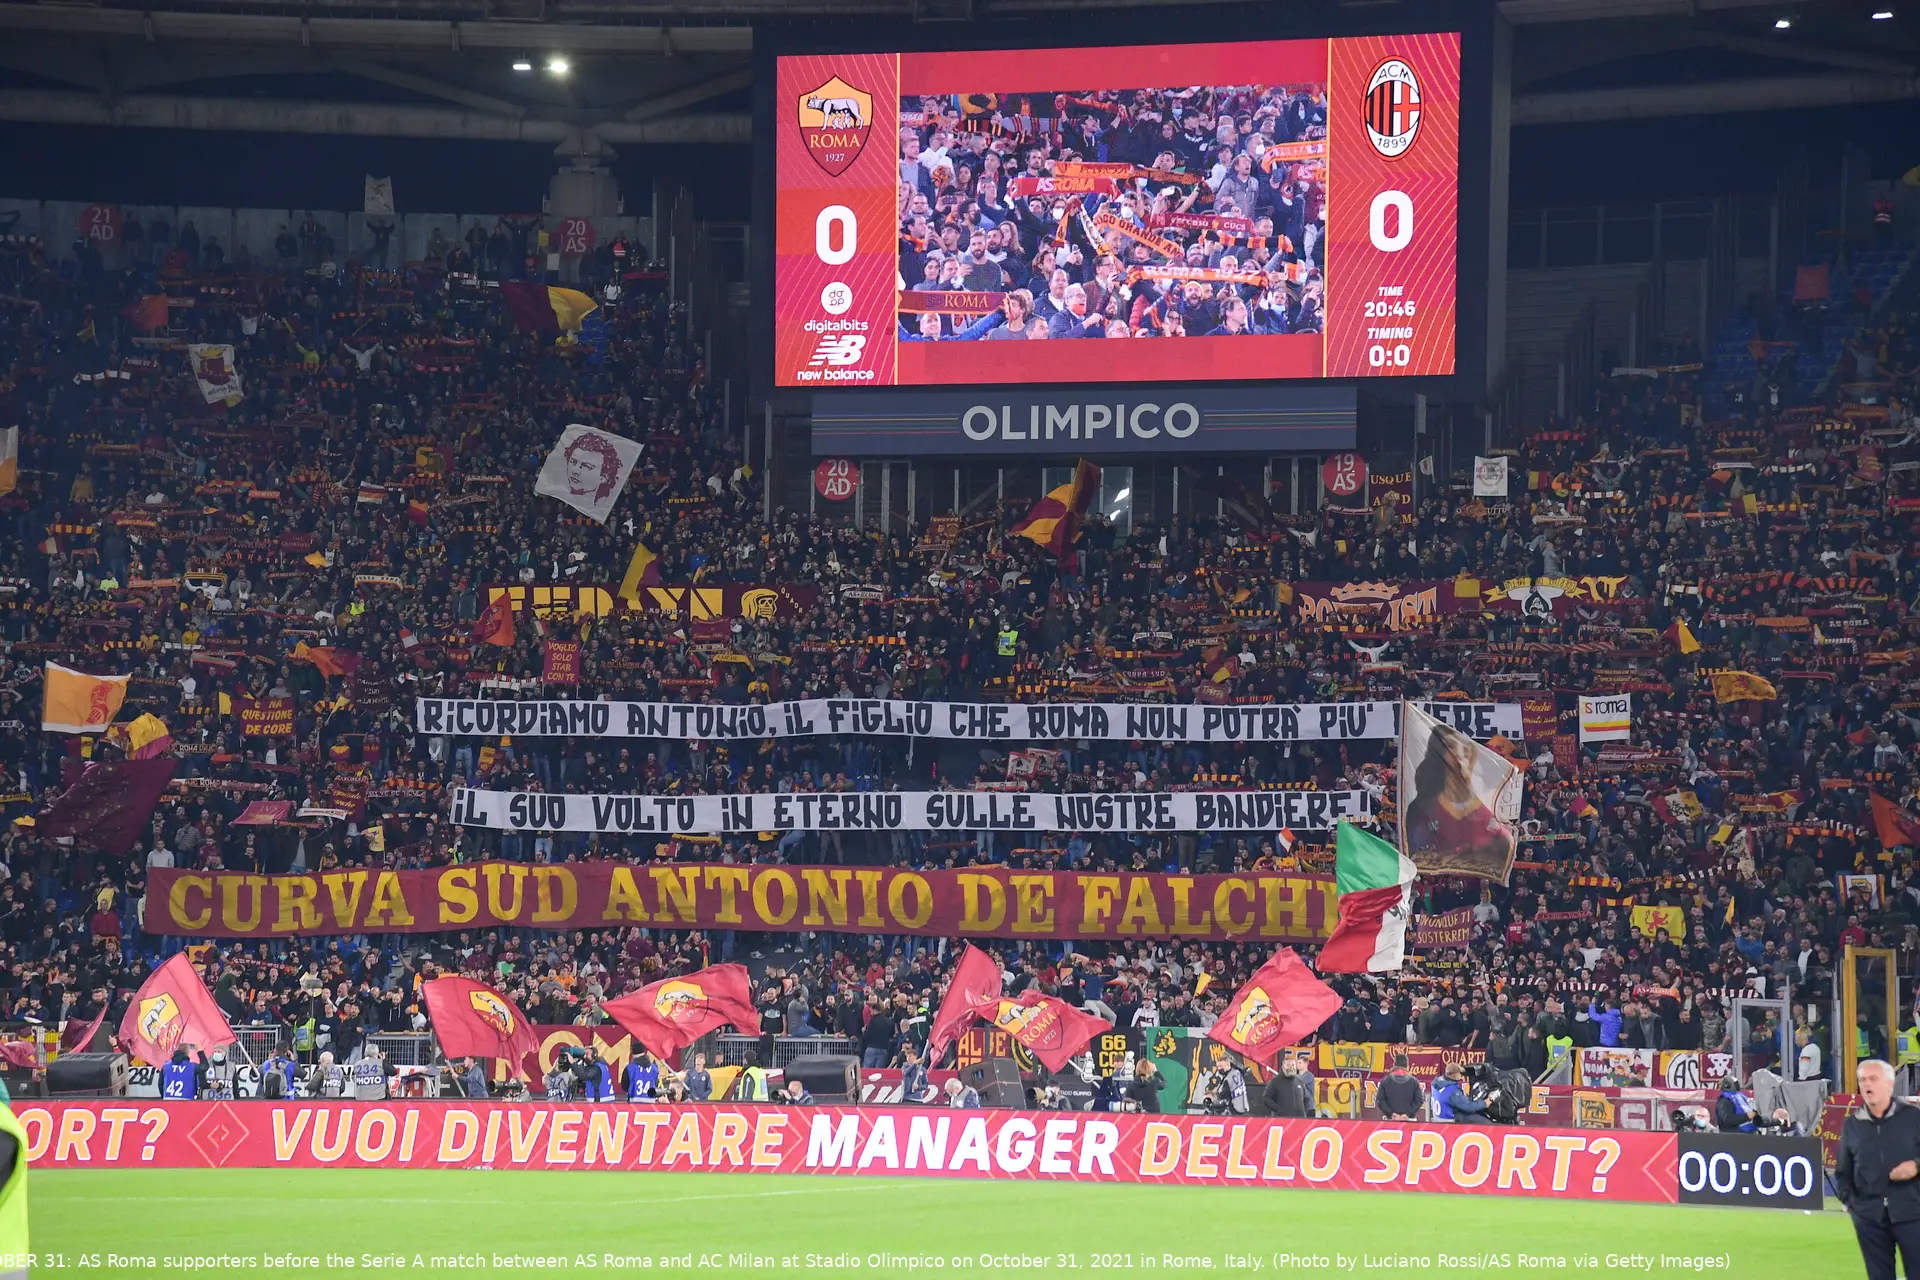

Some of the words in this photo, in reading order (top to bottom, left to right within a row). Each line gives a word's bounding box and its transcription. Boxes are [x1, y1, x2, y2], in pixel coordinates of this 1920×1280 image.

[1376, 64, 1411, 83] ACM
[810, 133, 860, 148] ROMA
[1377, 136, 1407, 149] 1899
[825, 153, 845, 162] 1927
[92, 206, 110, 224] 21
[1370, 190, 1413, 252] 0
[90, 226, 114, 241] AD
[567, 219, 586, 236] 20
[816, 205, 857, 265] 0
[566, 237, 587, 254] AS
[1378, 286, 1404, 297] TIME
[944, 294, 988, 308] ROMA
[1364, 300, 1416, 317] 20:46
[804, 319, 869, 334] digitalbits
[1367, 327, 1413, 340] TIMING
[1369, 344, 1411, 367] 0:0
[797, 370, 822, 380] new
[824, 368, 875, 380] balance
[961, 402, 1201, 441] OLIMPICO
[827, 459, 849, 478] 20
[1335, 453, 1355, 471] 19
[1333, 472, 1356, 491] AS
[1370, 471, 1412, 486] USQUE
[824, 477, 852, 497] AD
[547, 642, 577, 653] VOGLIO
[551, 653, 573, 662] SOLO
[551, 663, 572, 671] STAR
[547, 672, 562, 682] CON
[564, 672, 576, 681] TE
[241, 709, 293, 721] QUESTIONE
[1596, 700, 1629, 714] roma
[245, 724, 262, 735] DE
[263, 722, 293, 735] CORE
[949, 704, 1011, 738] CHE
[1028, 705, 1109, 738] ROMA
[1126, 706, 1188, 739] NON
[510, 794, 566, 829] SUO
[592, 796, 695, 832] VOLTO
[774, 795, 902, 829] ETERNO
[926, 794, 1036, 829] SULLE
[1055, 793, 1176, 830] NOSTRE
[168, 871, 415, 931] CURVA
[438, 863, 578, 925] SUD
[603, 866, 933, 928] ANTONIO
[957, 873, 1054, 932] DE
[1077, 875, 1340, 938] FALCHI
[1022, 1012, 1058, 1046] ROMA
[1042, 1028, 1058, 1045] 1927
[1101, 1034, 1127, 1051] 66
[172, 1064, 187, 1074] TV
[357, 1064, 379, 1075] 234
[1585, 1063, 1608, 1074] ROMA
[166, 1080, 184, 1097] 42
[356, 1075, 383, 1086] PHOTO
[207, 1089, 232, 1100] 036
[272, 1108, 420, 1163] VUOI
[437, 1109, 790, 1168] DIVENTARE
[804, 1112, 1120, 1176] MANAGER
[1139, 1121, 1345, 1183] DELLO
[1363, 1128, 1622, 1194] SPORT?
[1678, 1150, 1814, 1198] 00:00
